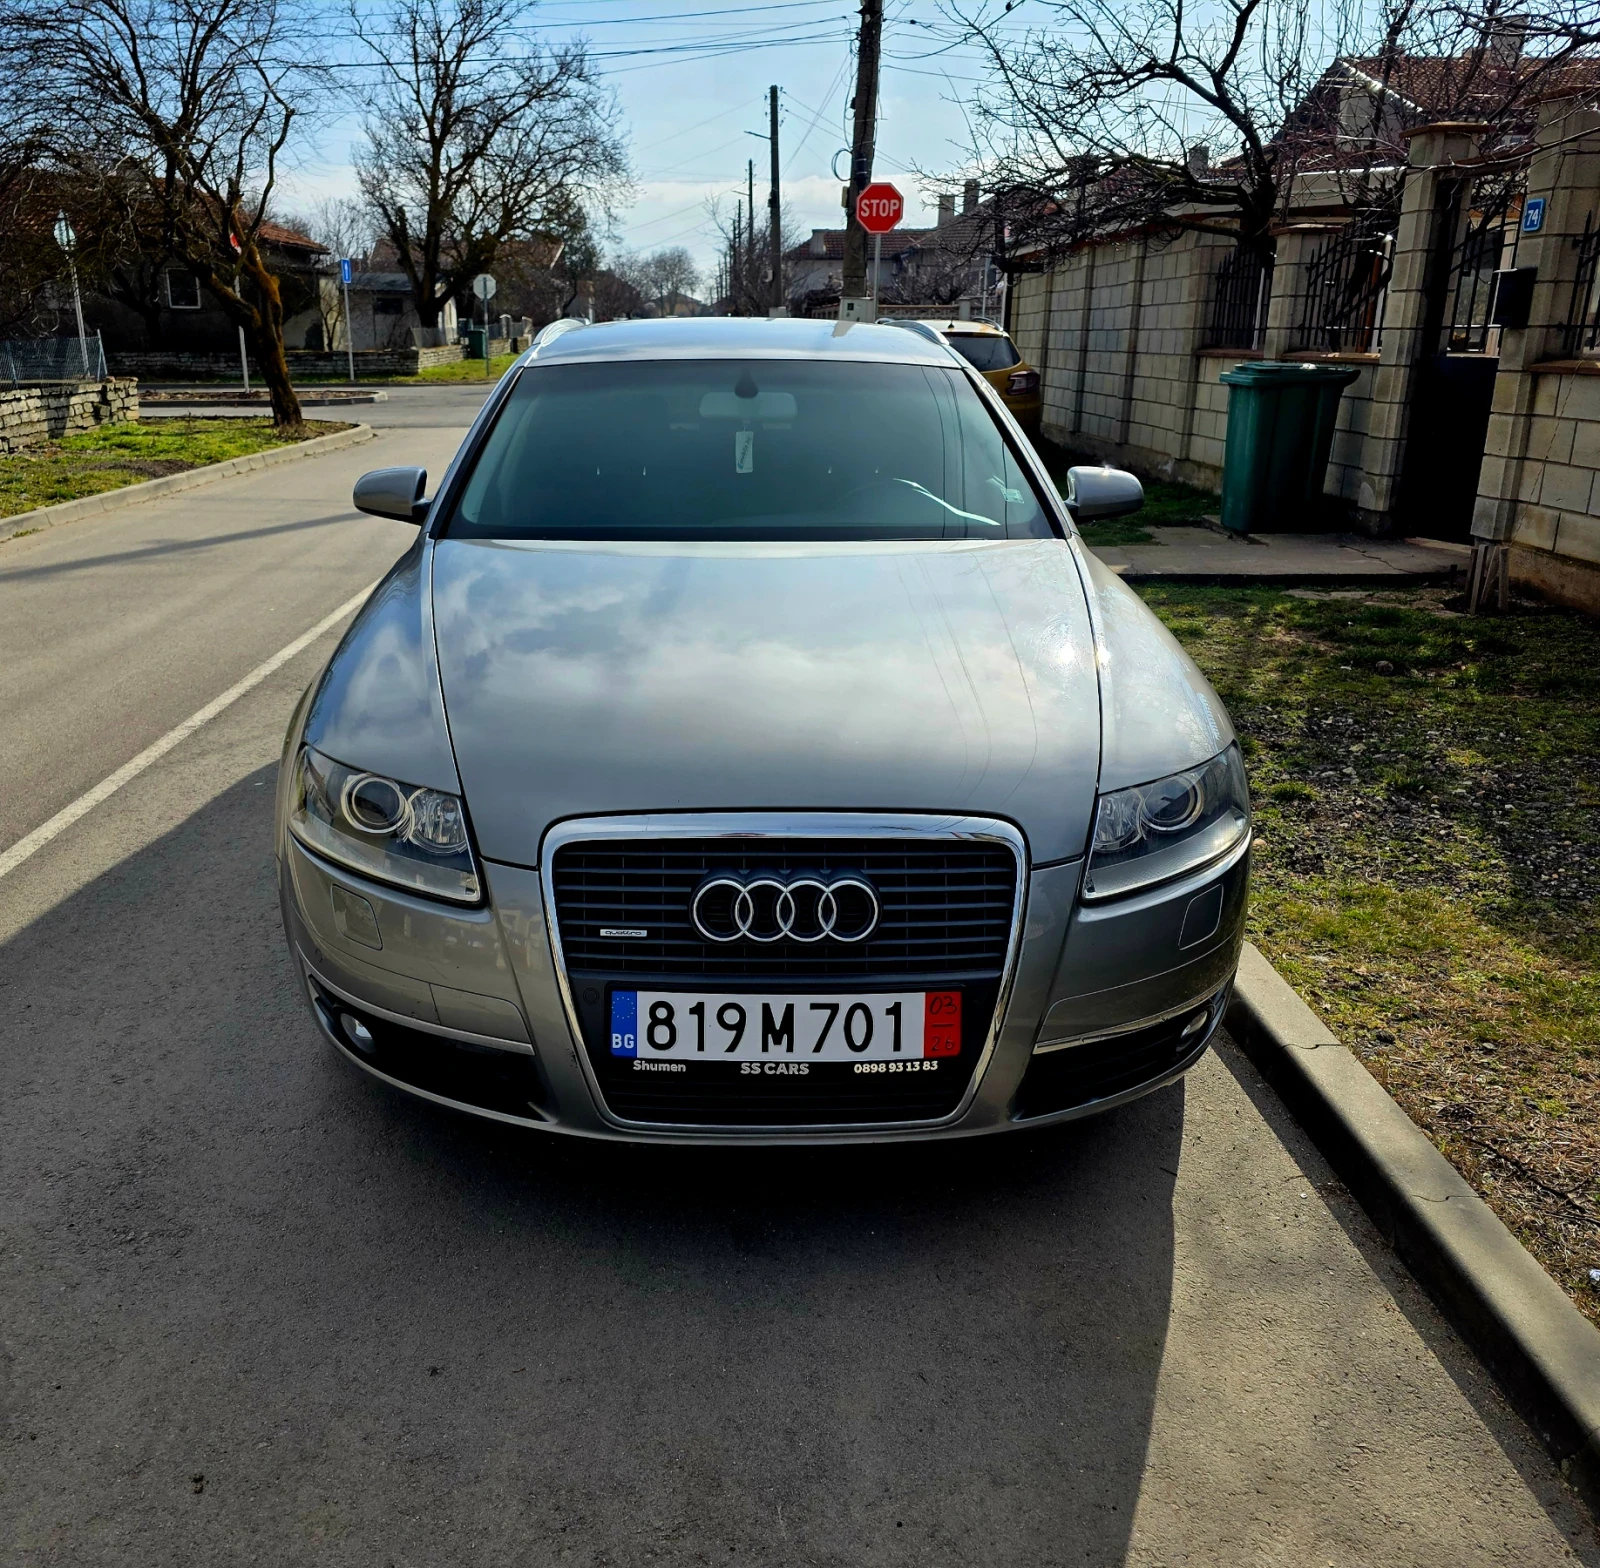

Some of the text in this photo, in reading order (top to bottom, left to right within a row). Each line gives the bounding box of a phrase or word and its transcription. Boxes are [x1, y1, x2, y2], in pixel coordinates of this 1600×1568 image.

[860, 199, 900, 217] STOP
[1527, 209, 1539, 226] 74
[930, 995, 958, 1015] 03
[612, 1033, 635, 1049] BG
[931, 1034, 955, 1052] 26
[633, 1060, 687, 1073] Shumen
[740, 1063, 810, 1076] SS CARS
[854, 1060, 939, 1074] 0898 93 13 83
